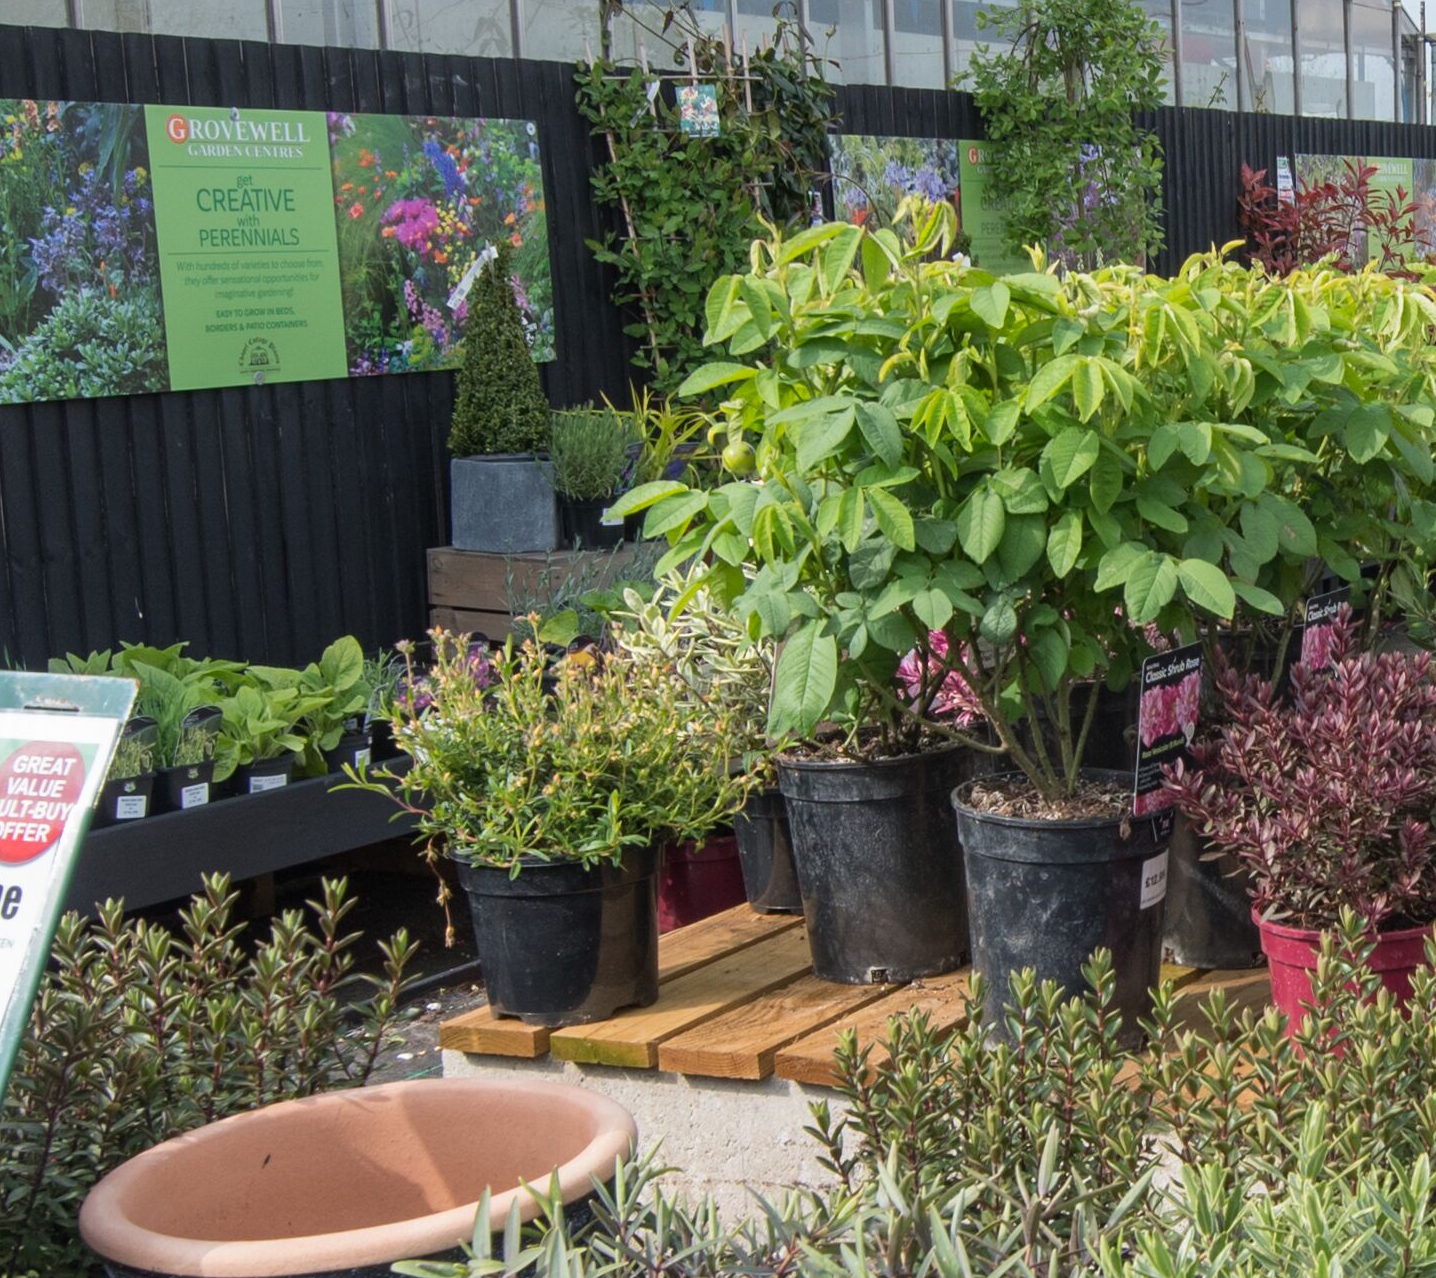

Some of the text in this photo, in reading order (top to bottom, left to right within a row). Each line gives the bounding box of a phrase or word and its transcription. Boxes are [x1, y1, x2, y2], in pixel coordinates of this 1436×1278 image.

[167, 118, 311, 143] GROVEWELL
[188, 144, 304, 158] GARDEN CENTRES
[236, 174, 253, 189] get
[196, 188, 296, 212] CREATIVE
[237, 214, 260, 226] with
[200, 228, 300, 247] PERENNIALS
[216, 310, 233, 318] EASY
[234, 309, 244, 318] TO
[244, 308, 264, 318] GROW
[266, 308, 274, 317] IN
[205, 322, 238, 333] BORDERS
[246, 322, 264, 332] PATIO
[266, 320, 308, 330] CONTAINERS
[1308, 607, 1323, 622] Classic
[1146, 656, 1200, 684] Classic Shrub Rose
[12, 754, 76, 776] GREAT
[6, 777, 66, 798] VALUE
